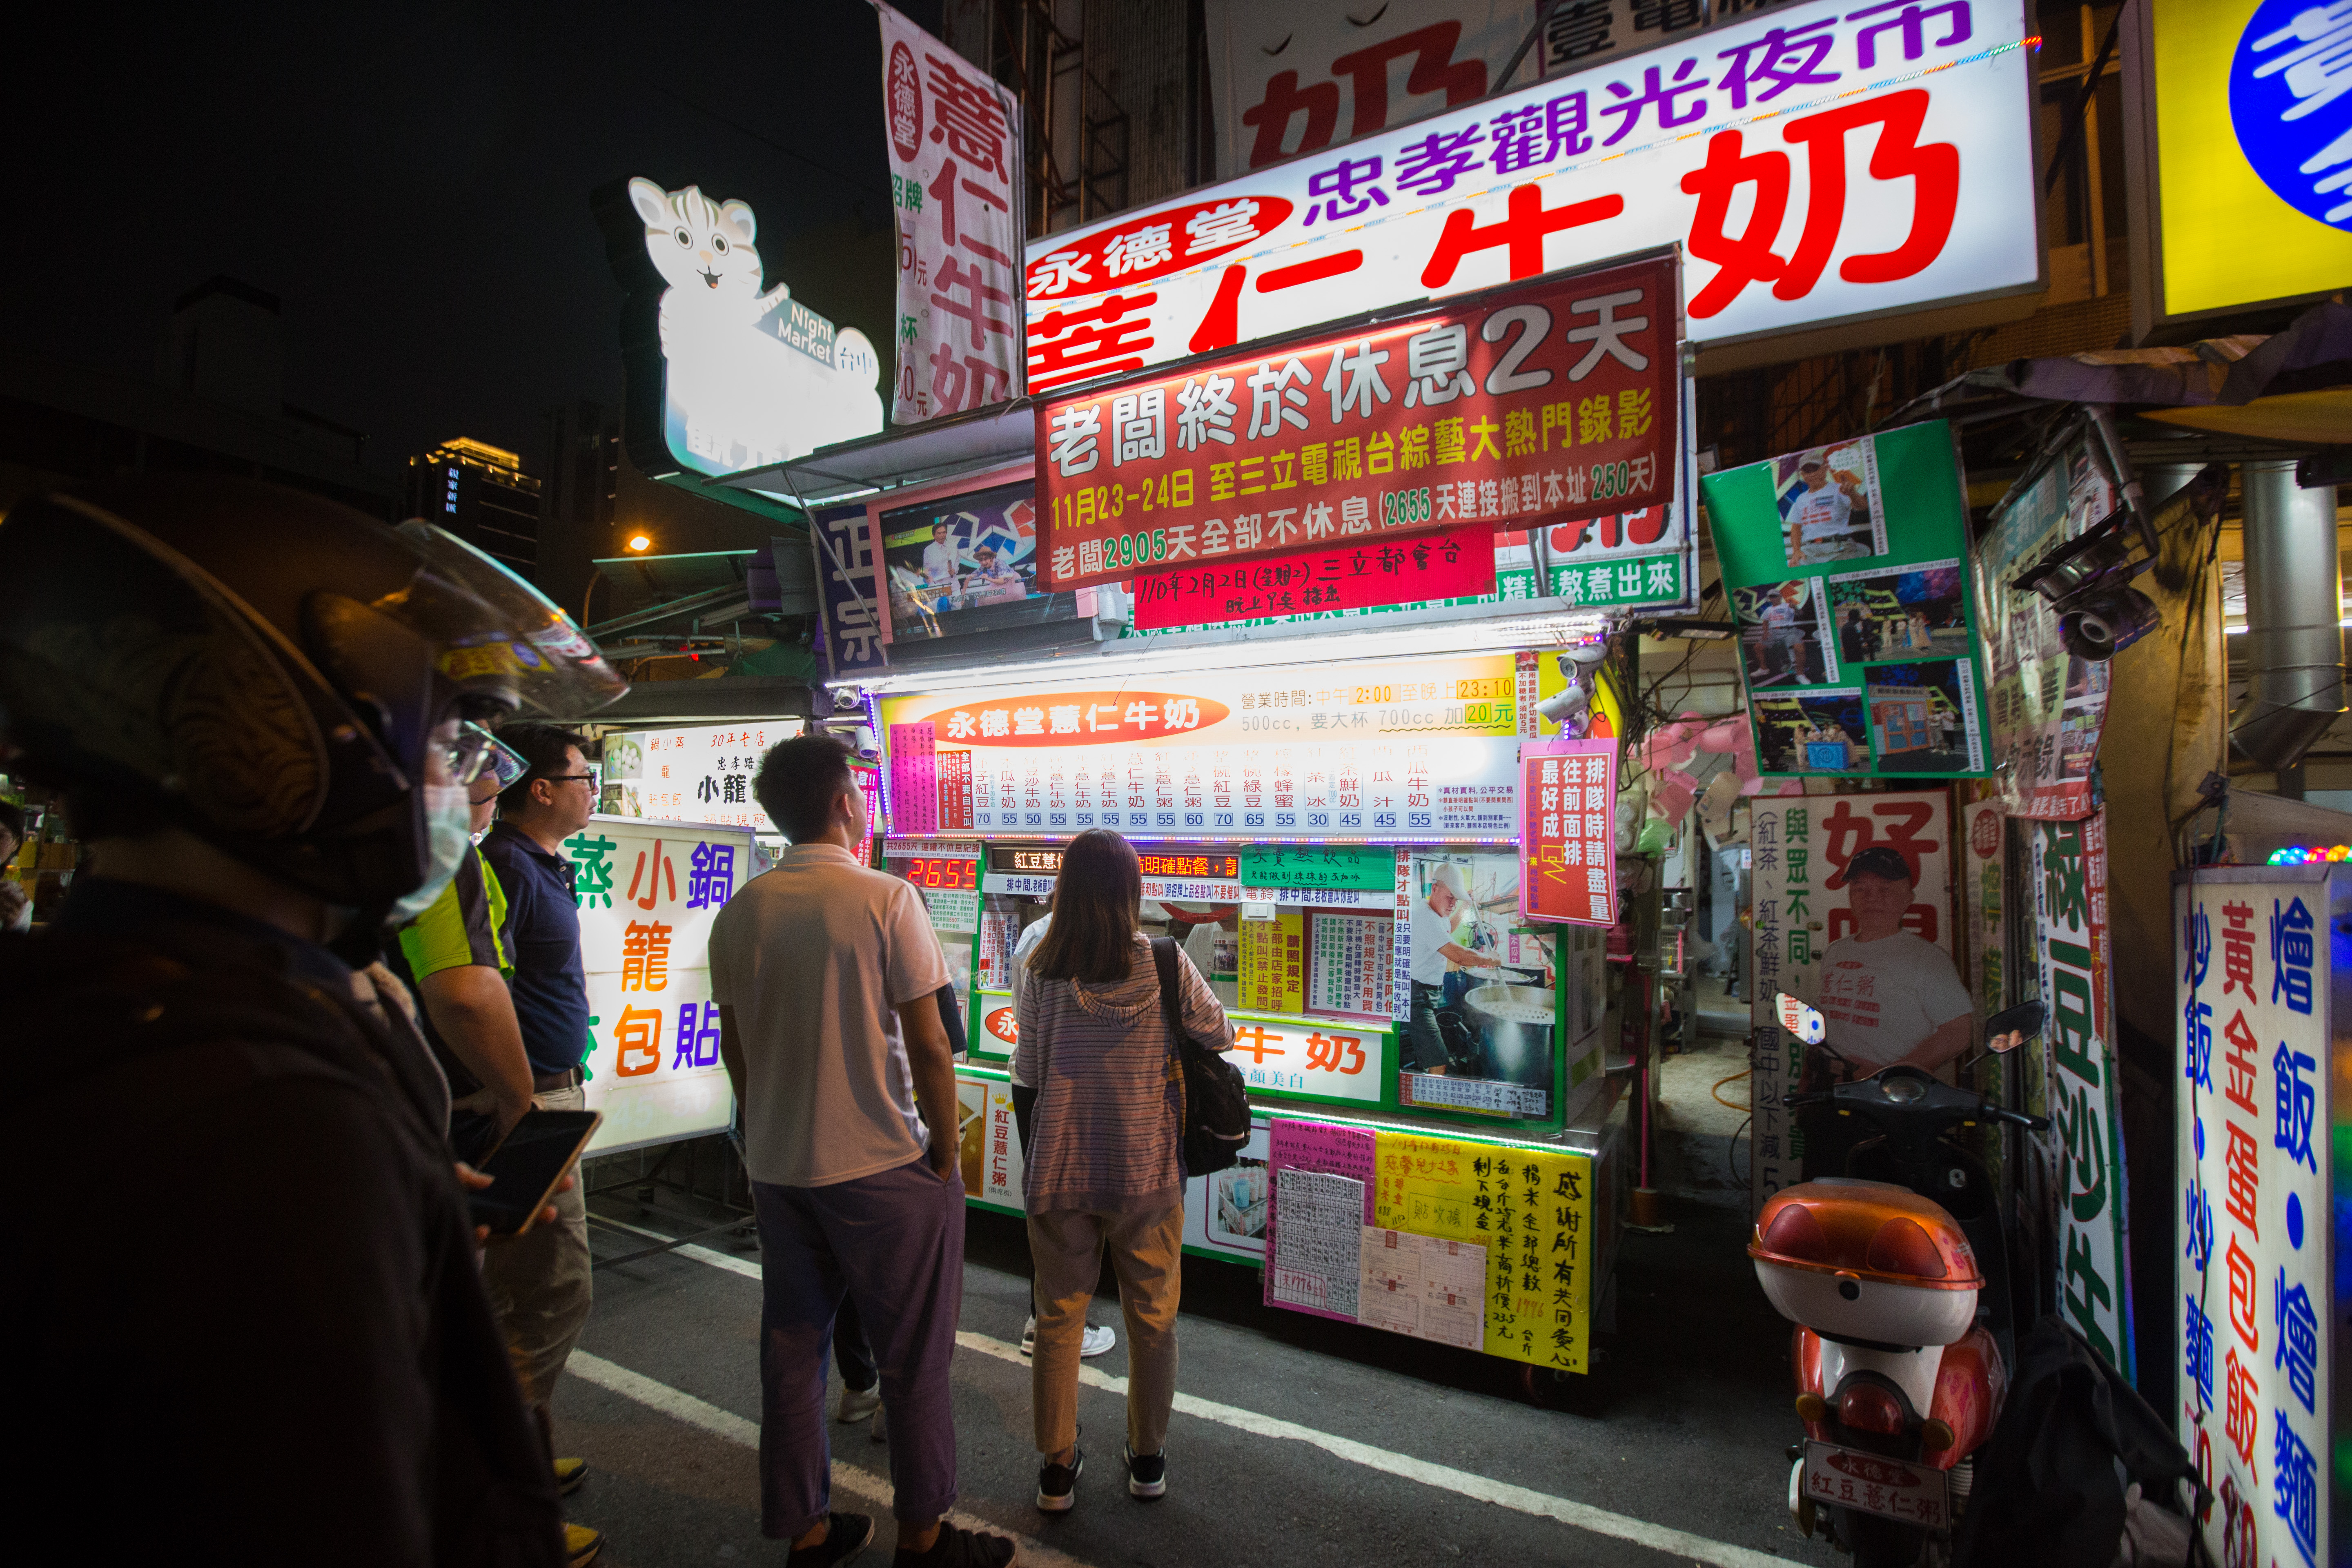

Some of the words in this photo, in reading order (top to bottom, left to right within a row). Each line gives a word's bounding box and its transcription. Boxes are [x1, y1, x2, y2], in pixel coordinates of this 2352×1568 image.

[893, 51, 916, 151] 永德堂
[1303, 0, 1974, 227] 忠孝觀光夜市
[924, 52, 1014, 419] 薏仁牛奶
[1028, 199, 1261, 299] 永德堂
[777, 322, 831, 364] Market
[791, 303, 833, 343] Night
[1050, 288, 1650, 479] 老闆終於休息2天
[1052, 468, 1194, 530] 11月23-24日
[1210, 387, 1652, 503] 至三立電視台綜藝大熱門錄影
[1051, 495, 1372, 579] 老闆2905天全部不休息
[947, 698, 1200, 739] 永德堂薏仁牛奶
[710, 731, 765, 748] 30年老店
[717, 756, 754, 771] 忠孝路
[697, 774, 747, 804] 小籠
[961, 751, 973, 827] 全部不要自己叫
[1541, 760, 1560, 838] 最好成
[977, 814, 989, 824] 70
[1003, 814, 1016, 824] 55
[1027, 814, 1040, 824] 50
[1051, 814, 1065, 824] 55
[1078, 814, 1092, 824] 55
[1104, 814, 1118, 824] 55
[1131, 814, 1146, 824] 55
[1158, 814, 1174, 824] 55
[1187, 814, 1203, 824] 60
[1215, 814, 1232, 824] 70
[1246, 814, 1263, 824] 65
[1277, 814, 1294, 825] 55
[1309, 814, 1327, 825] 30
[1341, 814, 1360, 825] 45
[1376, 814, 1395, 825] 45
[1410, 814, 1430, 825] 55
[1563, 759, 1583, 866] 往前面排
[886, 842, 918, 851] 共2655天
[922, 842, 980, 853] 連續不休息紀錄
[1586, 757, 1610, 921] 排隊時請盡量
[907, 859, 976, 888] 2655
[1245, 887, 1274, 901] 電鈴
[1396, 849, 1411, 922] 排隊才點叫
[613, 839, 677, 1078] 小籠包
[673, 840, 735, 1071] 鍋貼
[1271, 920, 1283, 1011] 全部由店家招呼
[1286, 935, 1300, 993] 請照規定
[1335, 919, 1345, 1008] 不熟新來客戶要求回應者
[1353, 920, 1363, 999] 果汁機在運轉時聲音大
[1362, 921, 1376, 1012] 不照規定不用買
[1232, 1025, 1367, 1075] 牛奶
[992, 1109, 1009, 1187] 紅豆薏仁粥
[2221, 899, 2259, 1487] 黃金蛋包飯
[1812, 1472, 1941, 1524] 紅豆薏仁粥
